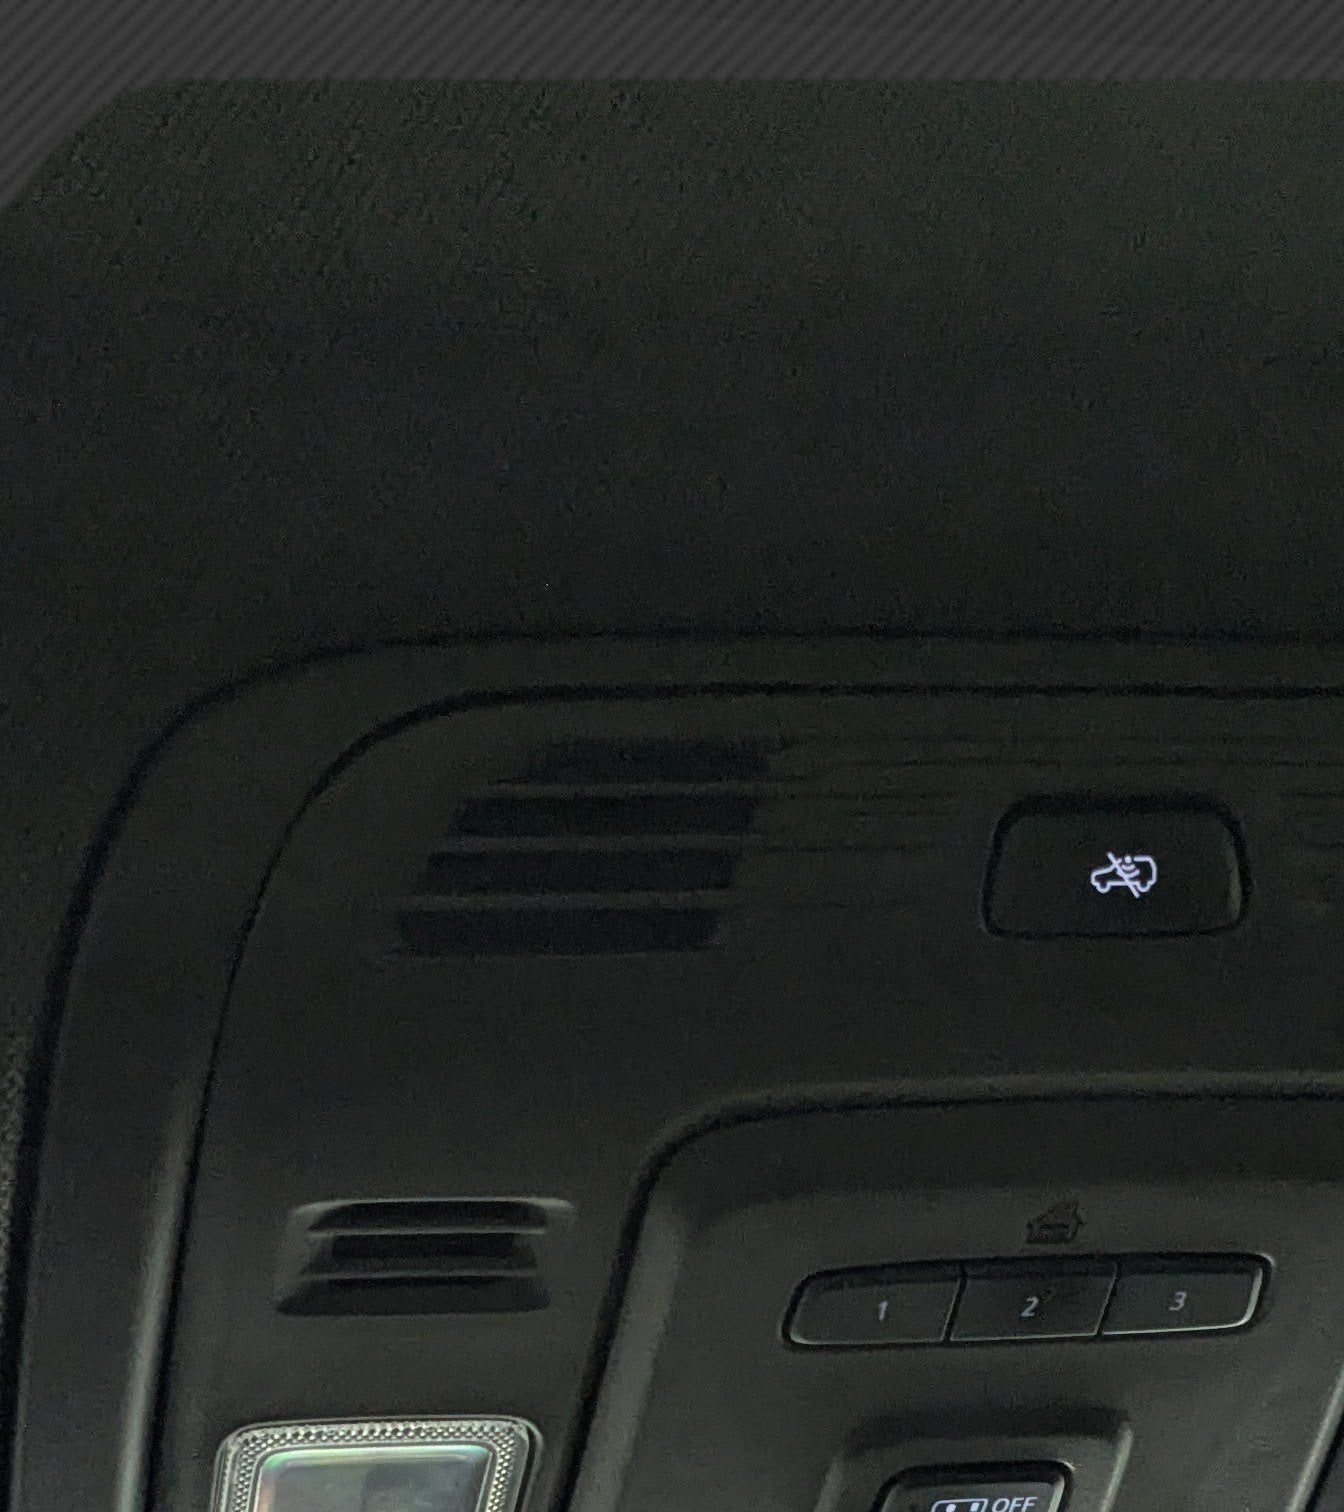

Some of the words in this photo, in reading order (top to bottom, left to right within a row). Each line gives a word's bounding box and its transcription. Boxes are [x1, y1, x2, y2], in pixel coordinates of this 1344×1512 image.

[877, 1300, 888, 1321] 1
[1020, 1295, 1039, 1317] 2
[1169, 1291, 1187, 1311] 3
